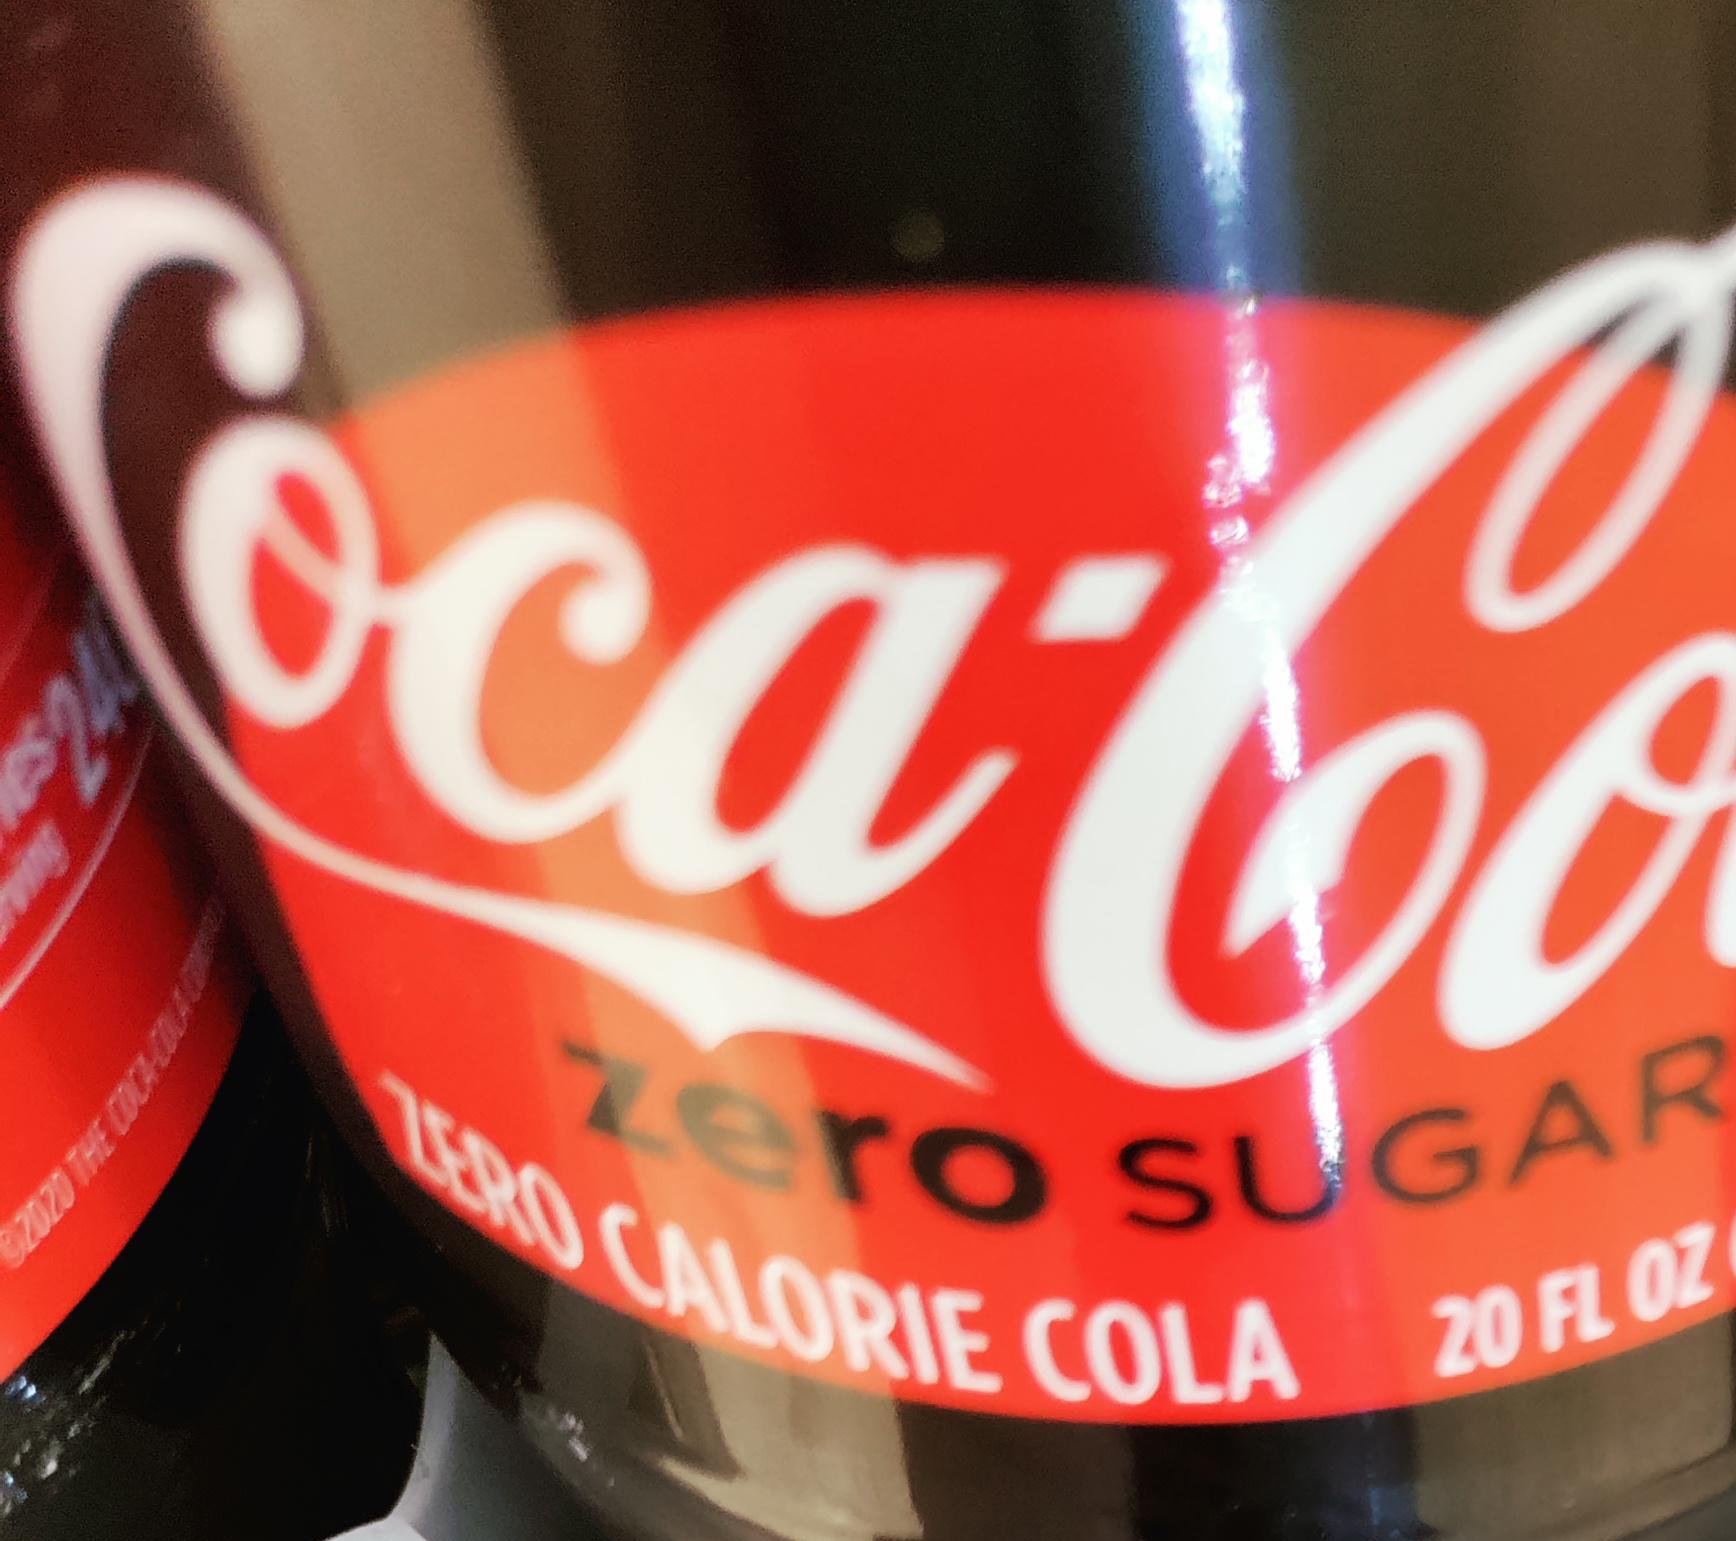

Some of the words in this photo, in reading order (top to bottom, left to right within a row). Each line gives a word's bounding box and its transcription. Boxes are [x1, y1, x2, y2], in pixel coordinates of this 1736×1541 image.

[560, 1035, 1047, 1230] zero
[1115, 1033, 1732, 1234] SUGAR
[376, 1070, 586, 1272] ZERO
[600, 1202, 1003, 1396] CALORIE
[1021, 1297, 1302, 1407] COLA
[1431, 1284, 1524, 1378] 20
[1539, 1262, 1616, 1354] FL
[1627, 1219, 1716, 1325] OZ
